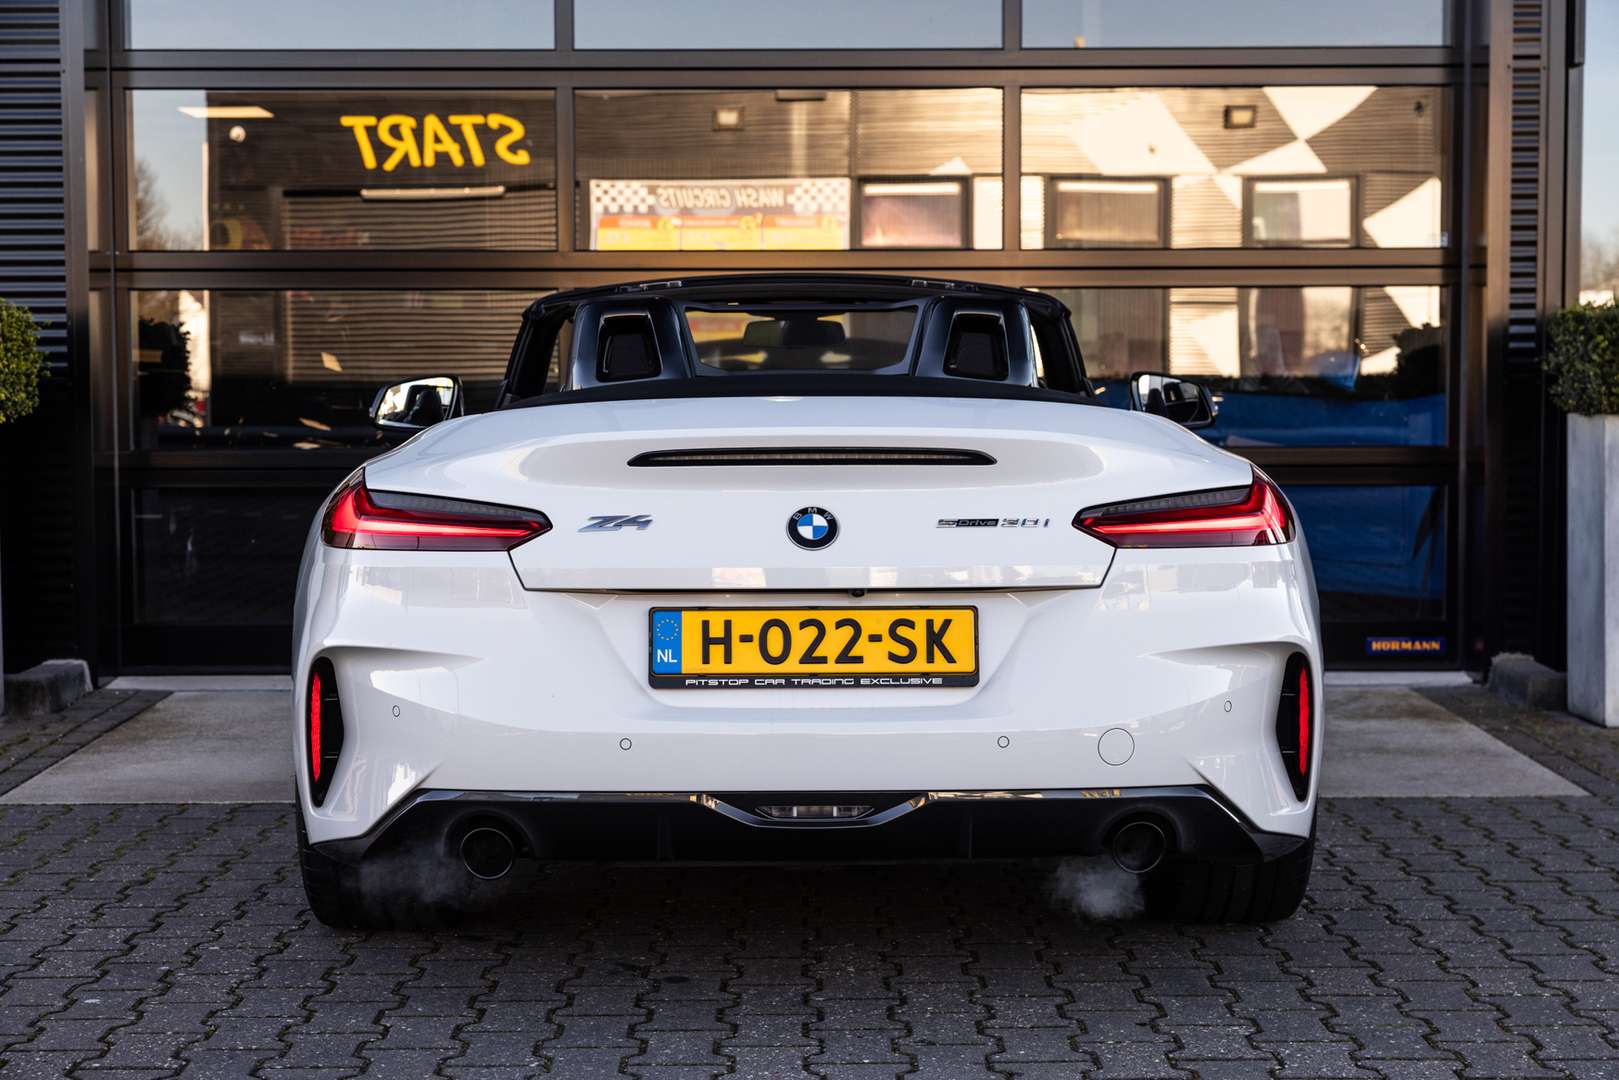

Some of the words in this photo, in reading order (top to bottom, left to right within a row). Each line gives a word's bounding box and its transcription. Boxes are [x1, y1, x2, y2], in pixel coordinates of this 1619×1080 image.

[577, 514, 653, 532] Z4
[701, 618, 957, 665] H-022-SK
[656, 648, 678, 663] NL
[685, 678, 749, 686] PITSTOP
[754, 678, 785, 686] CAR
[791, 677, 855, 686] TRADING
[860, 676, 943, 685] EXCLUSIVE
